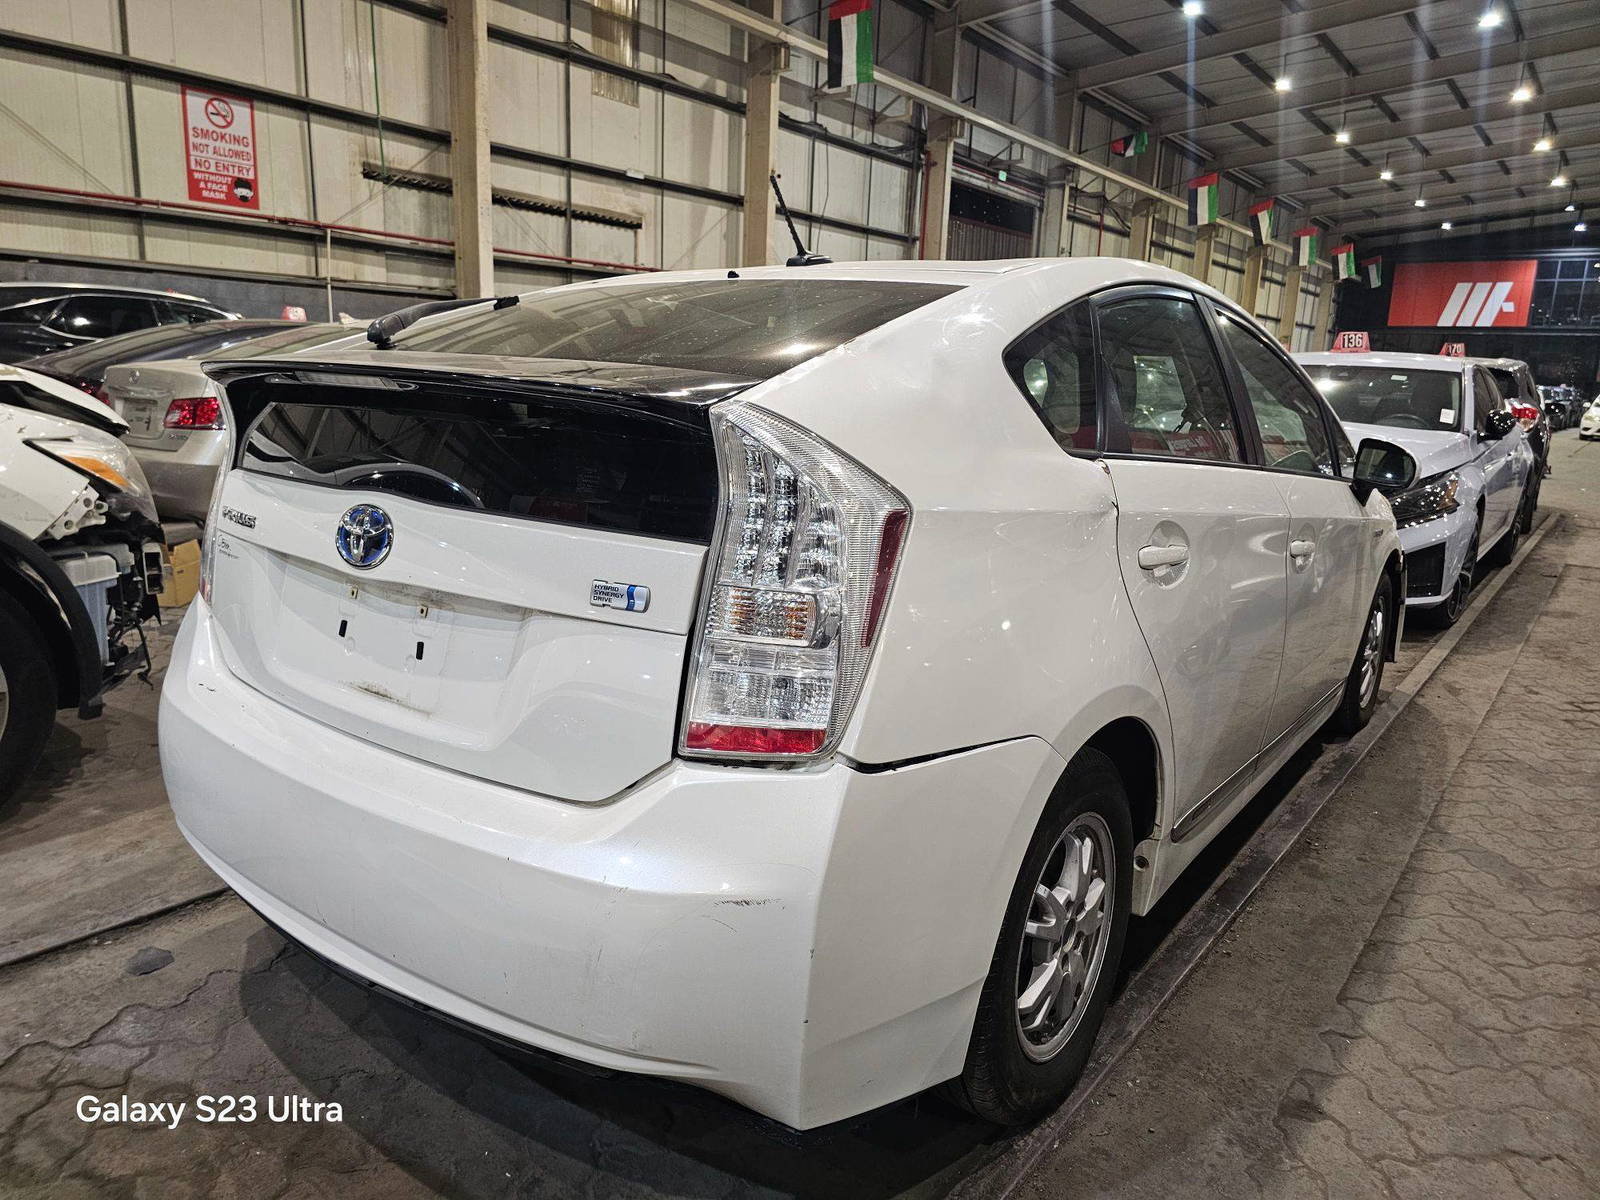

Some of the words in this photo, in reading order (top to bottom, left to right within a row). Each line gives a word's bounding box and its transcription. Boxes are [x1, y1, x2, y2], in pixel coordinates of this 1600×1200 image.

[192, 127, 250, 147] SMOKING
[192, 142, 210, 154] NOT
[213, 146, 251, 162] ALLOWED
[194, 158, 211, 170] NO
[215, 161, 252, 176] ENTRY
[193, 171, 232, 184] WITHOUT
[1343, 334, 1363, 348] 136
[593, 590, 624, 599] SYNERGY
[594, 584, 619, 592] HYBRID
[593, 595, 613, 603] DRIVE
